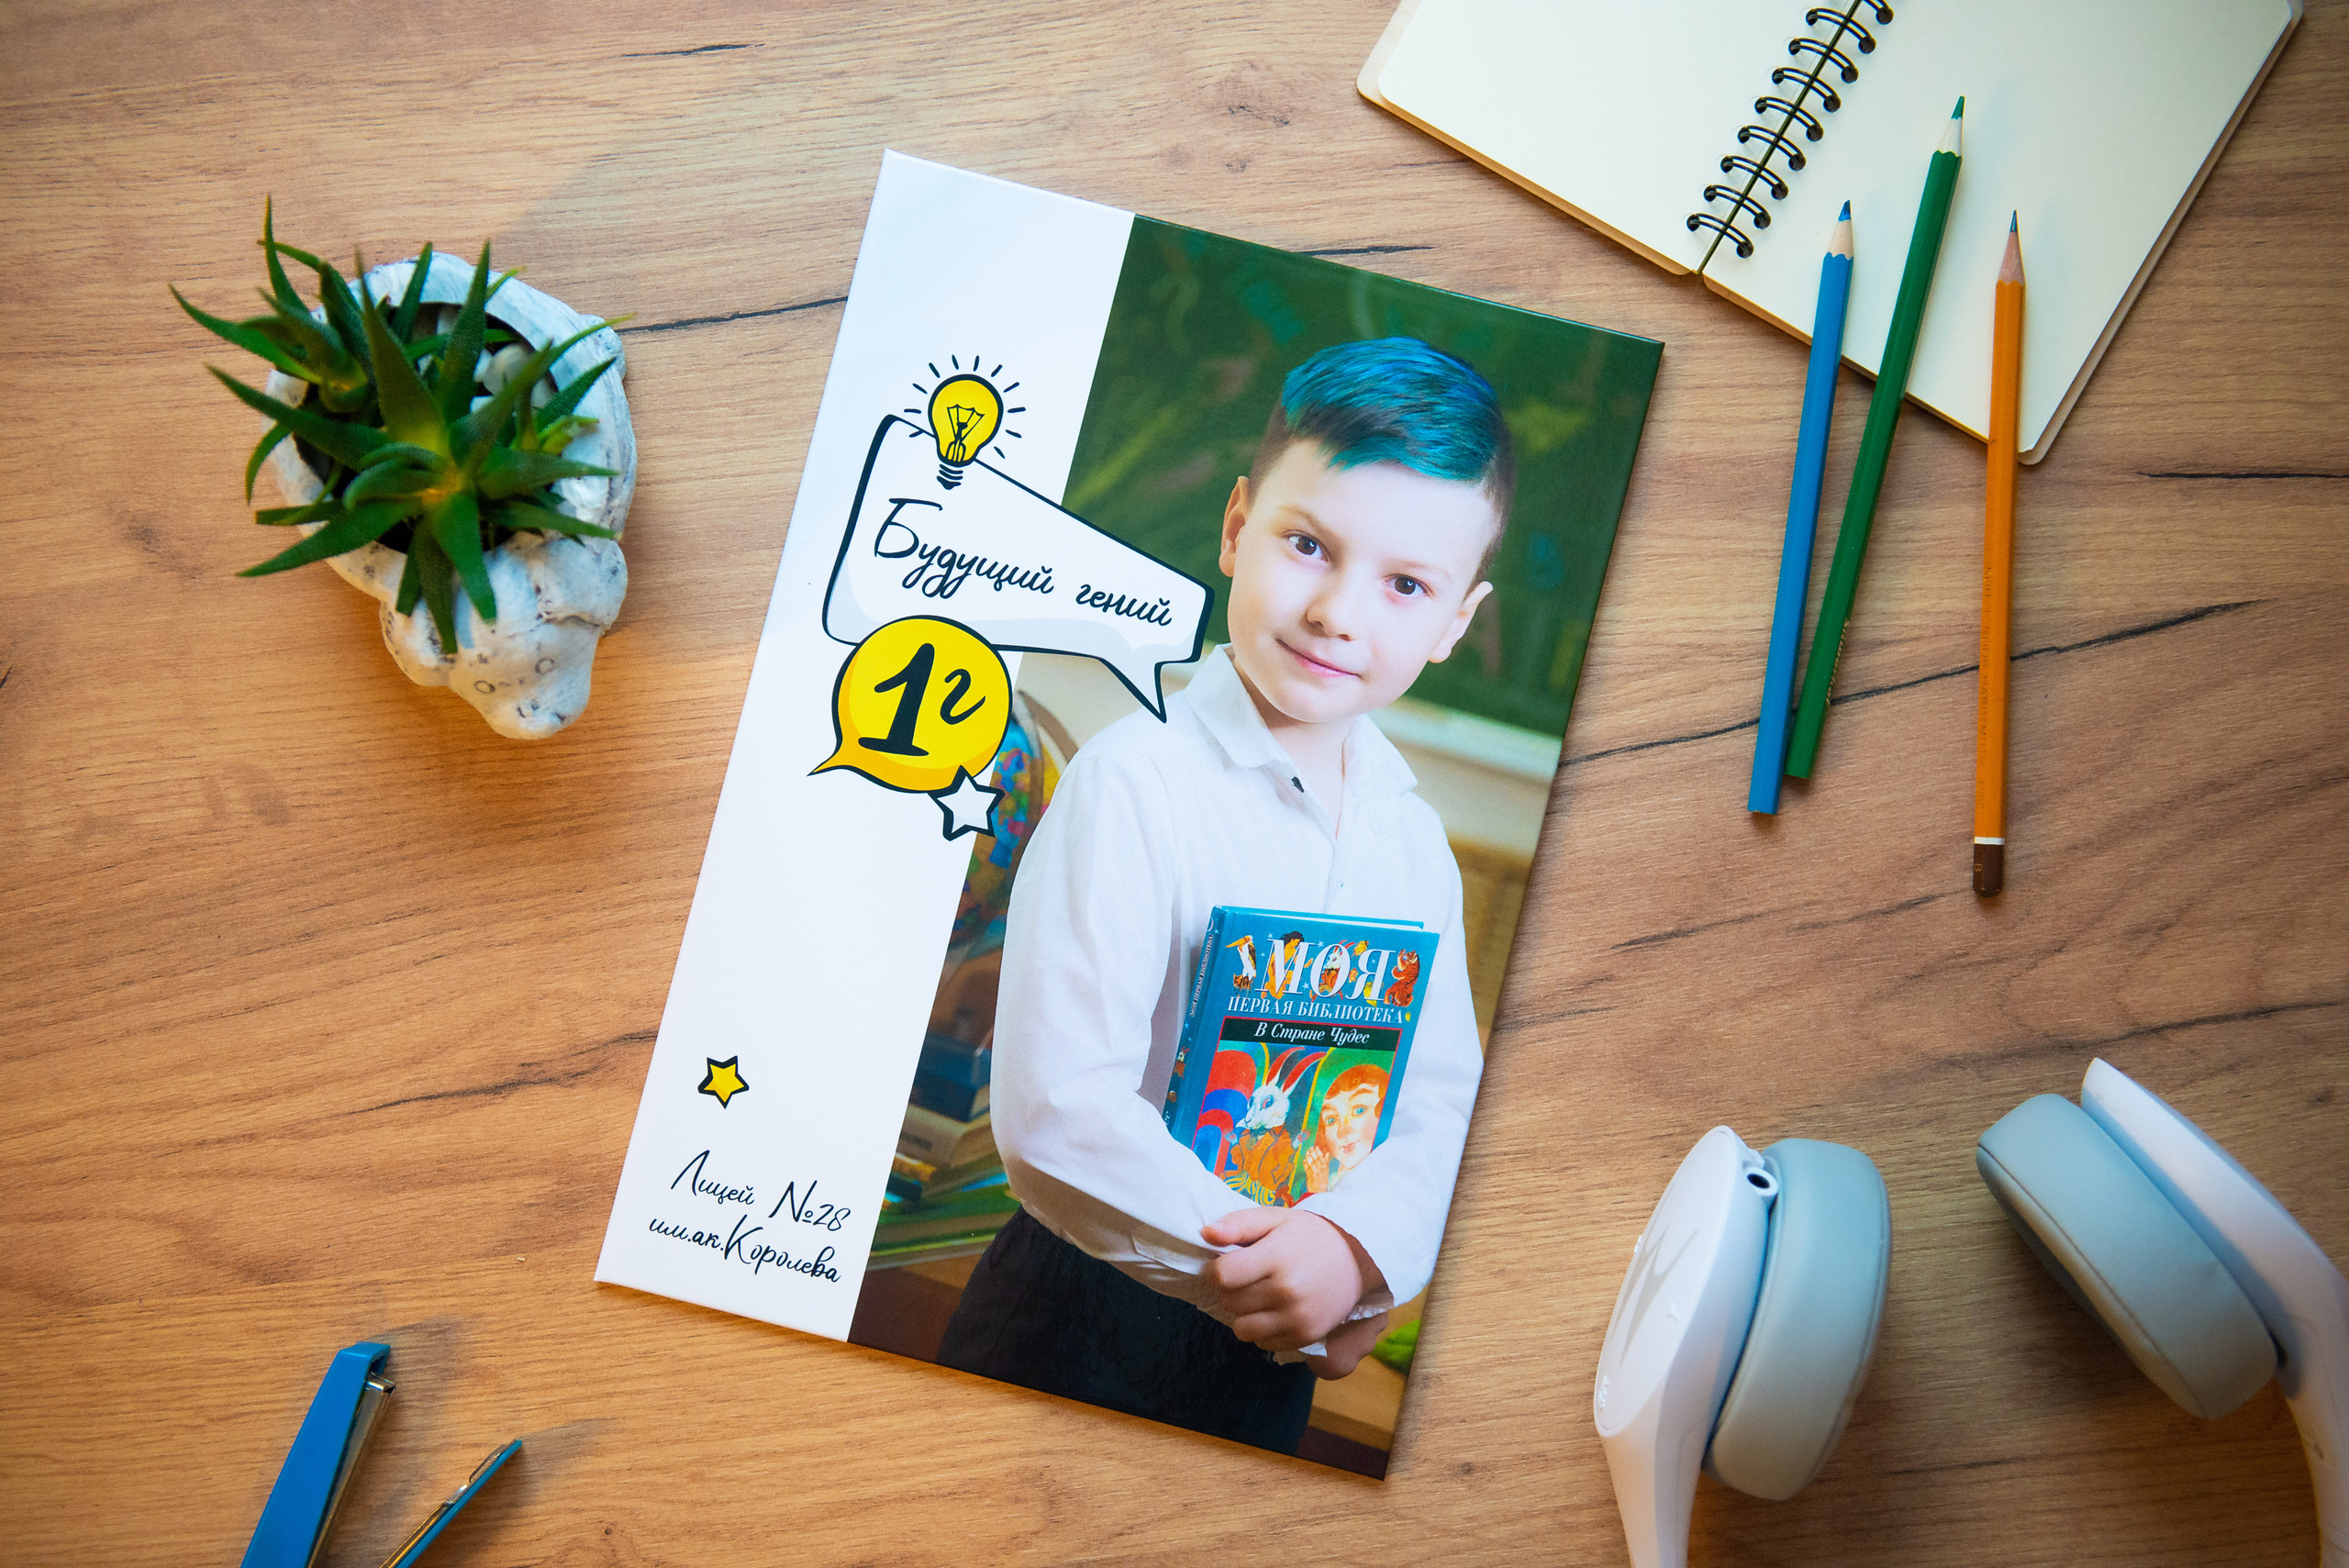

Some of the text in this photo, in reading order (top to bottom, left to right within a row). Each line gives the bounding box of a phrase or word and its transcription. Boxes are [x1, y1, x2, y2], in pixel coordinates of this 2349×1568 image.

[874, 498, 1173, 627] Будущий гений
[1254, 939, 1396, 1001] МОЯ
[1228, 996, 1403, 1024] ПЕРВАЯ БИБЛИОТЕКА
[1253, 1022, 1370, 1046] В Стране Чудес
[671, 1150, 852, 1232] Лицей №28
